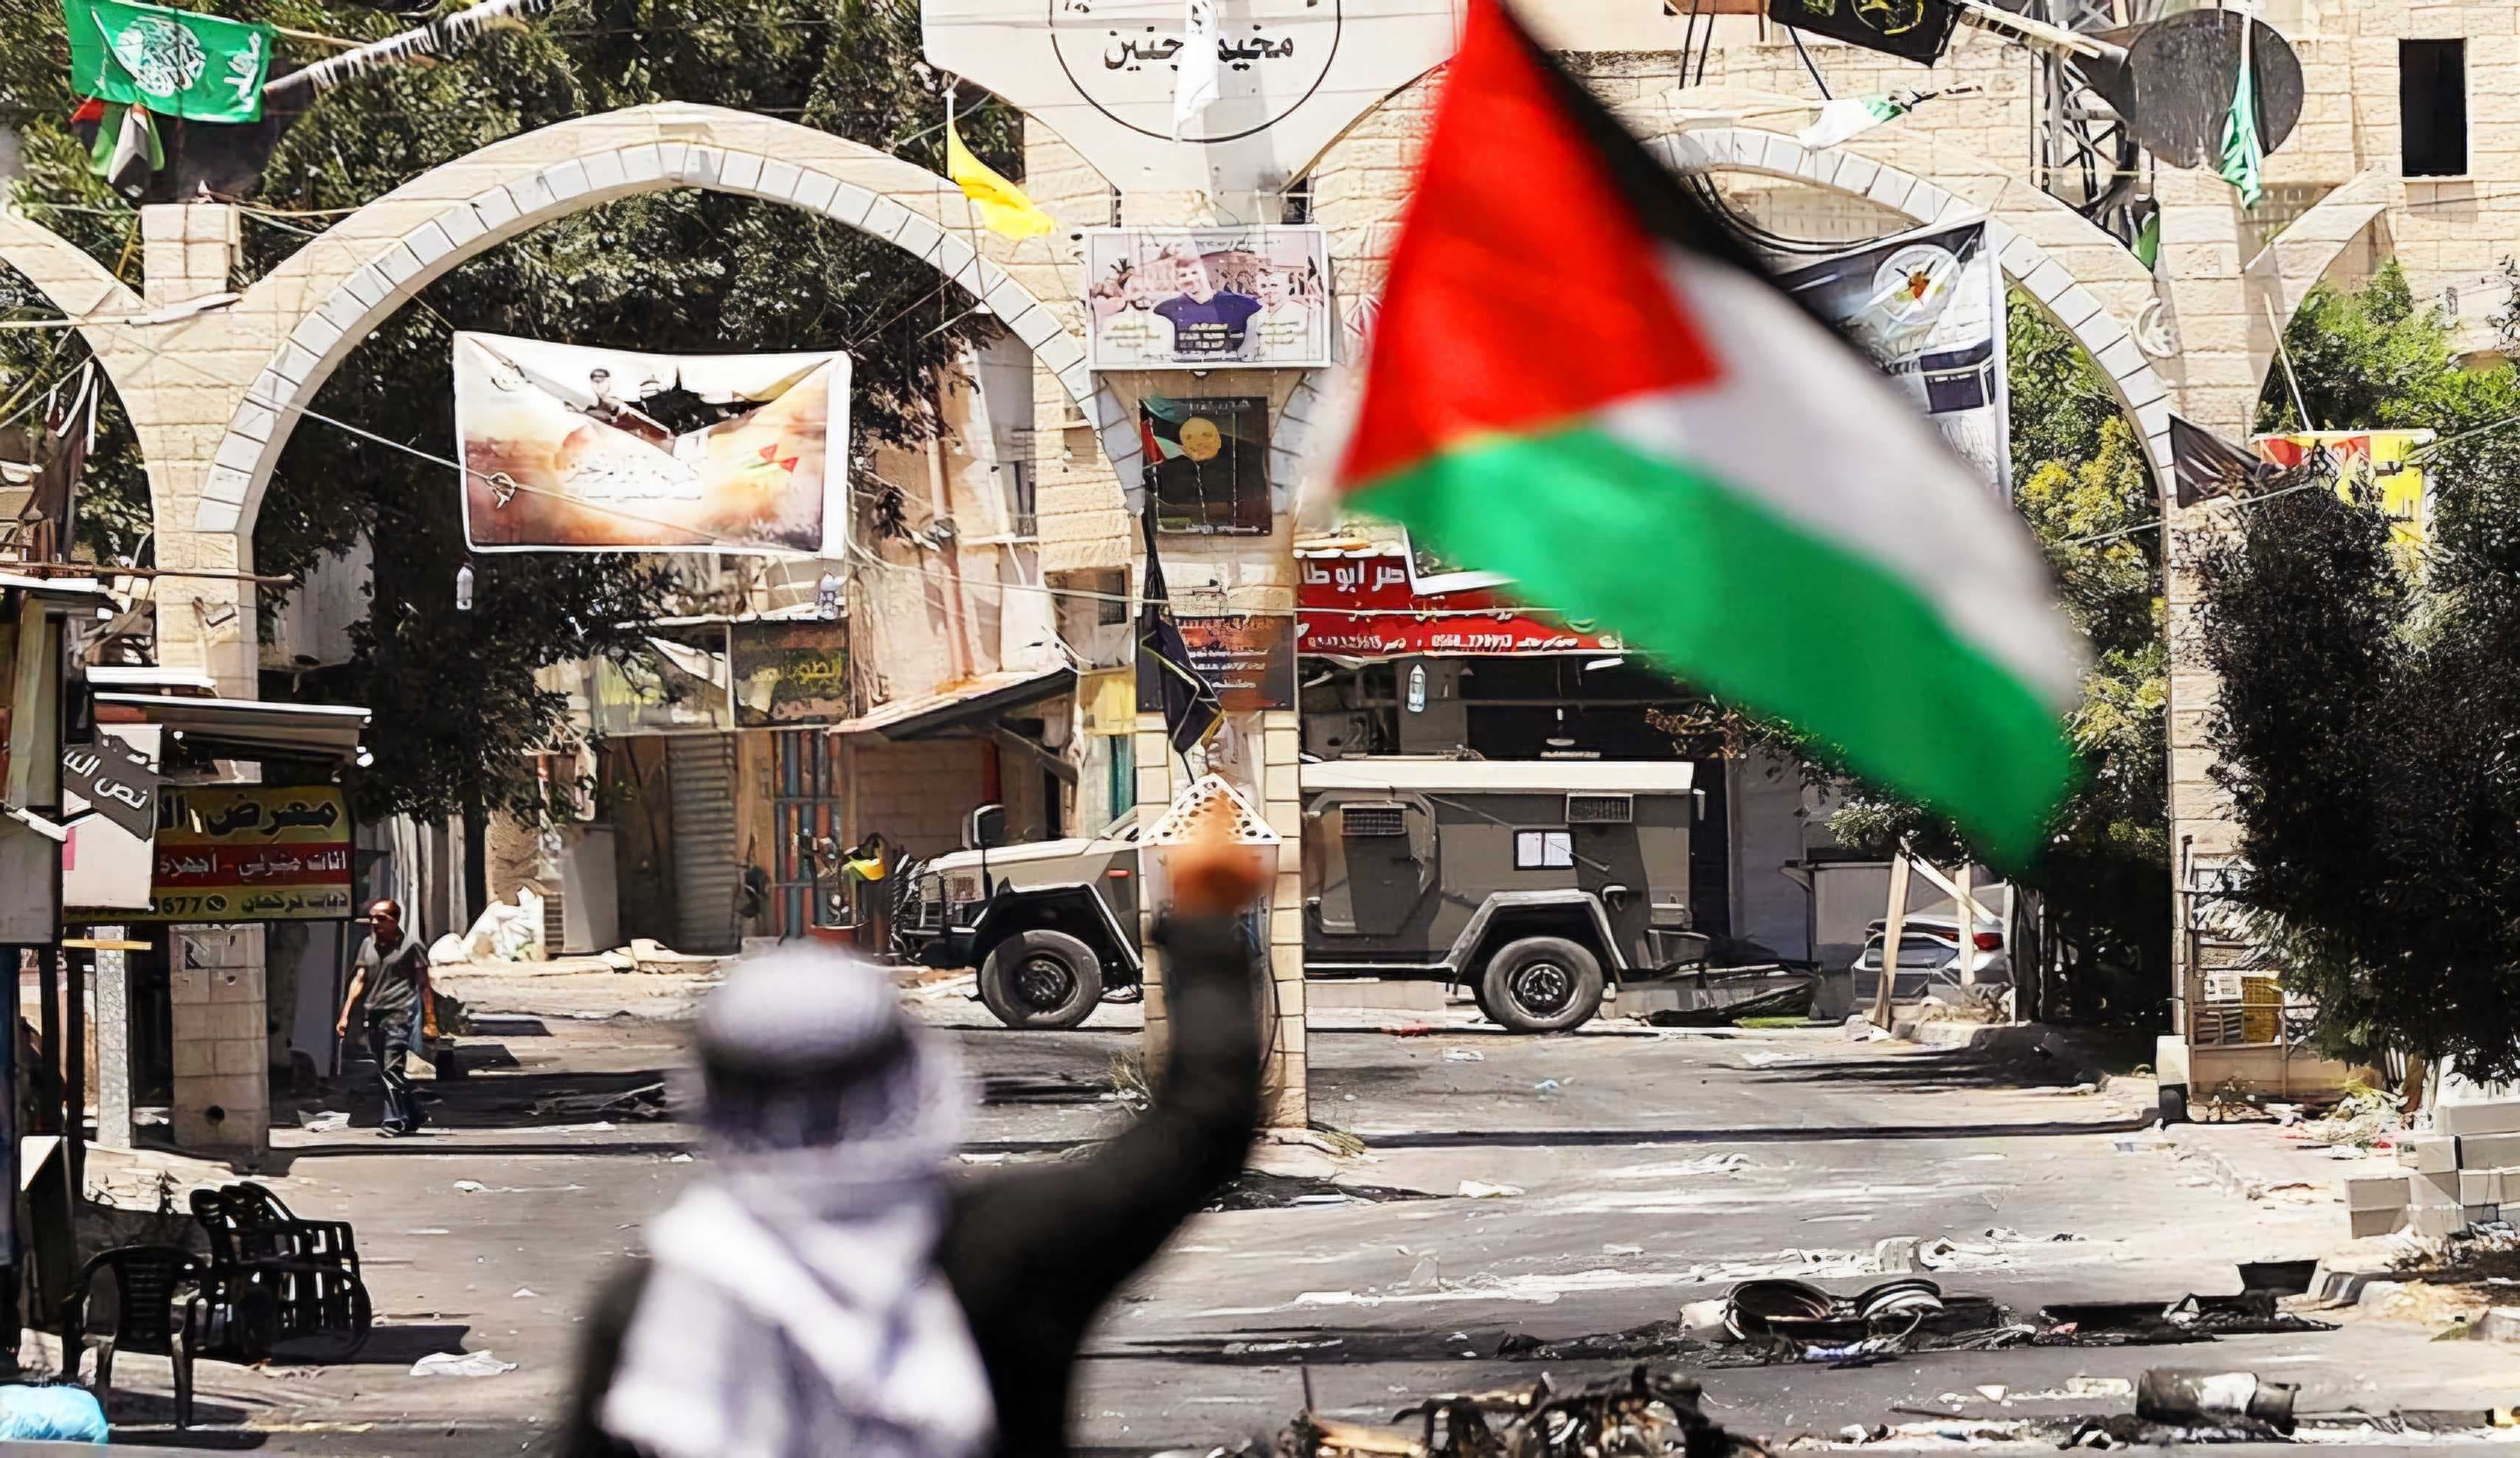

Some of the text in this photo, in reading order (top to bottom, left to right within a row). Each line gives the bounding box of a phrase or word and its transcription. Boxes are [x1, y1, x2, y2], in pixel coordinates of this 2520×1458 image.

[1104, 26, 1184, 70] جنين
[1302, 560, 1405, 593] صر ابو طا
[206, 792, 339, 839] معرض
